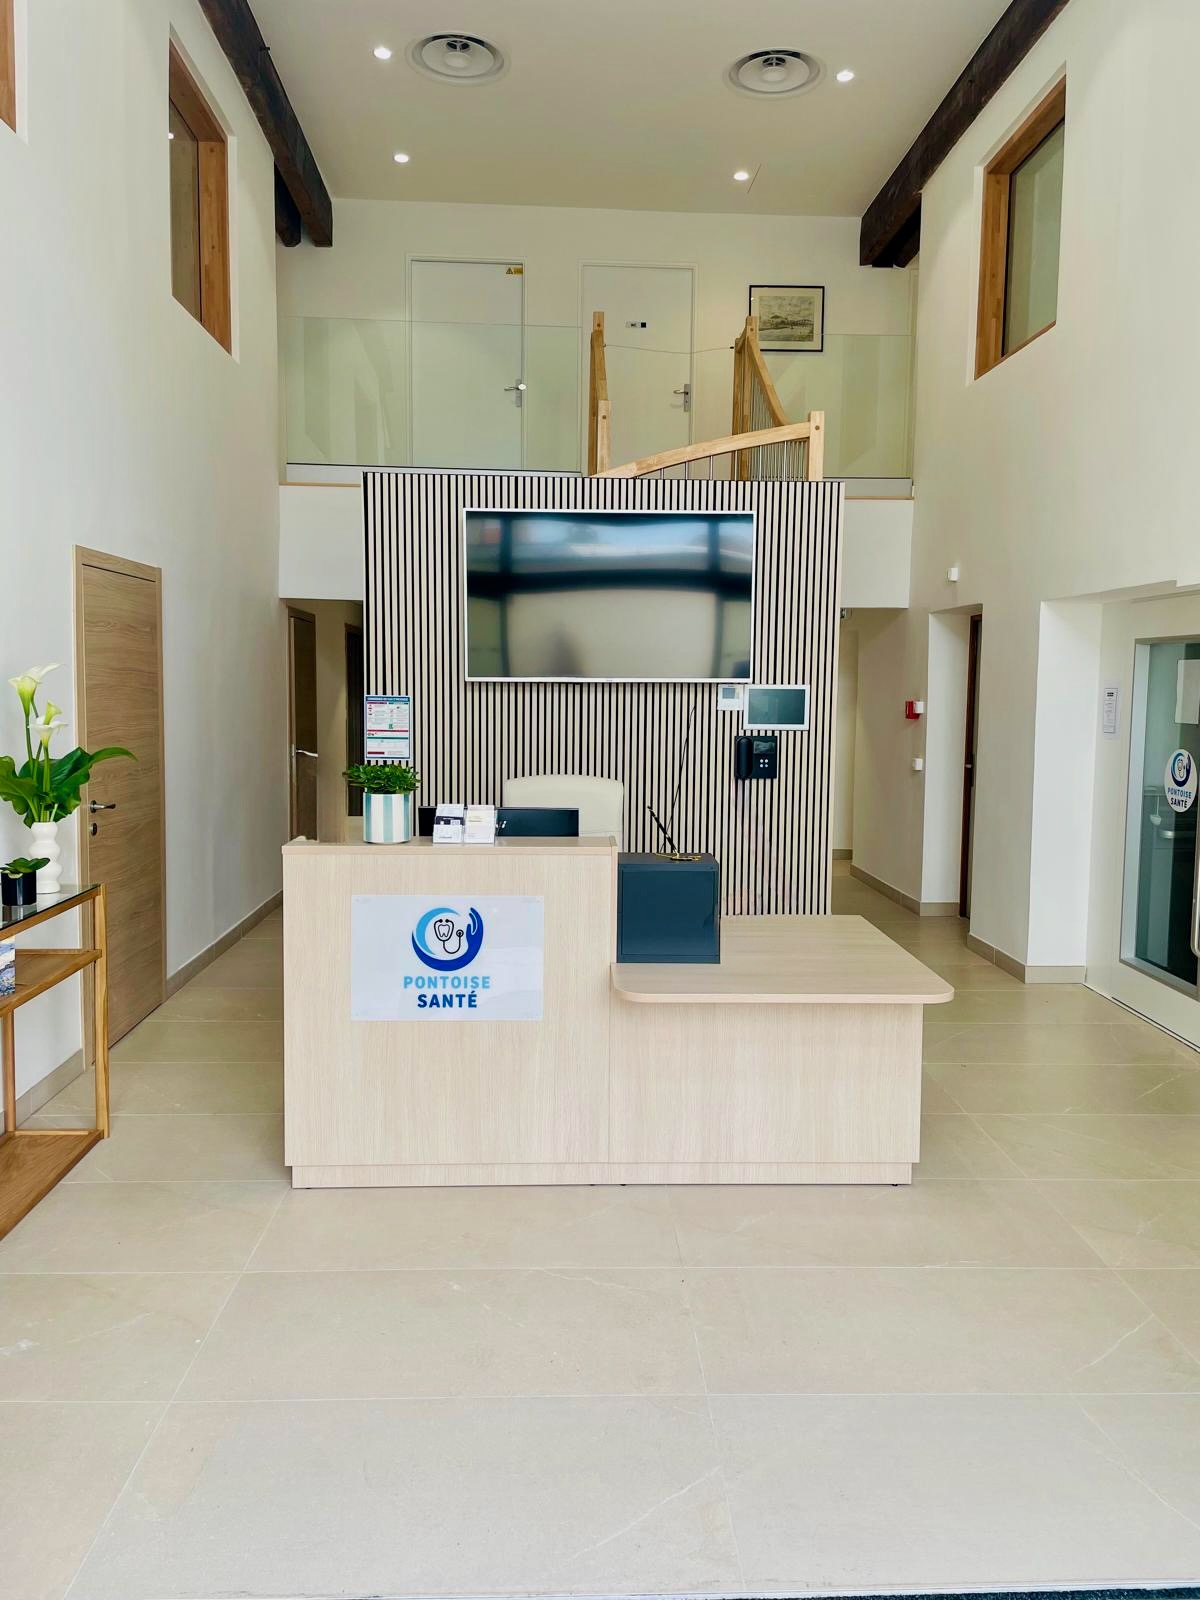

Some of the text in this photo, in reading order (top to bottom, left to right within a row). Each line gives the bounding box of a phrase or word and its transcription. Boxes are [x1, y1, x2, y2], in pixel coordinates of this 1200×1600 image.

[1167, 787, 1192, 799] PONTOISE
[403, 975, 490, 989] PONTOISE
[417, 990, 478, 1008] SANTÉ
